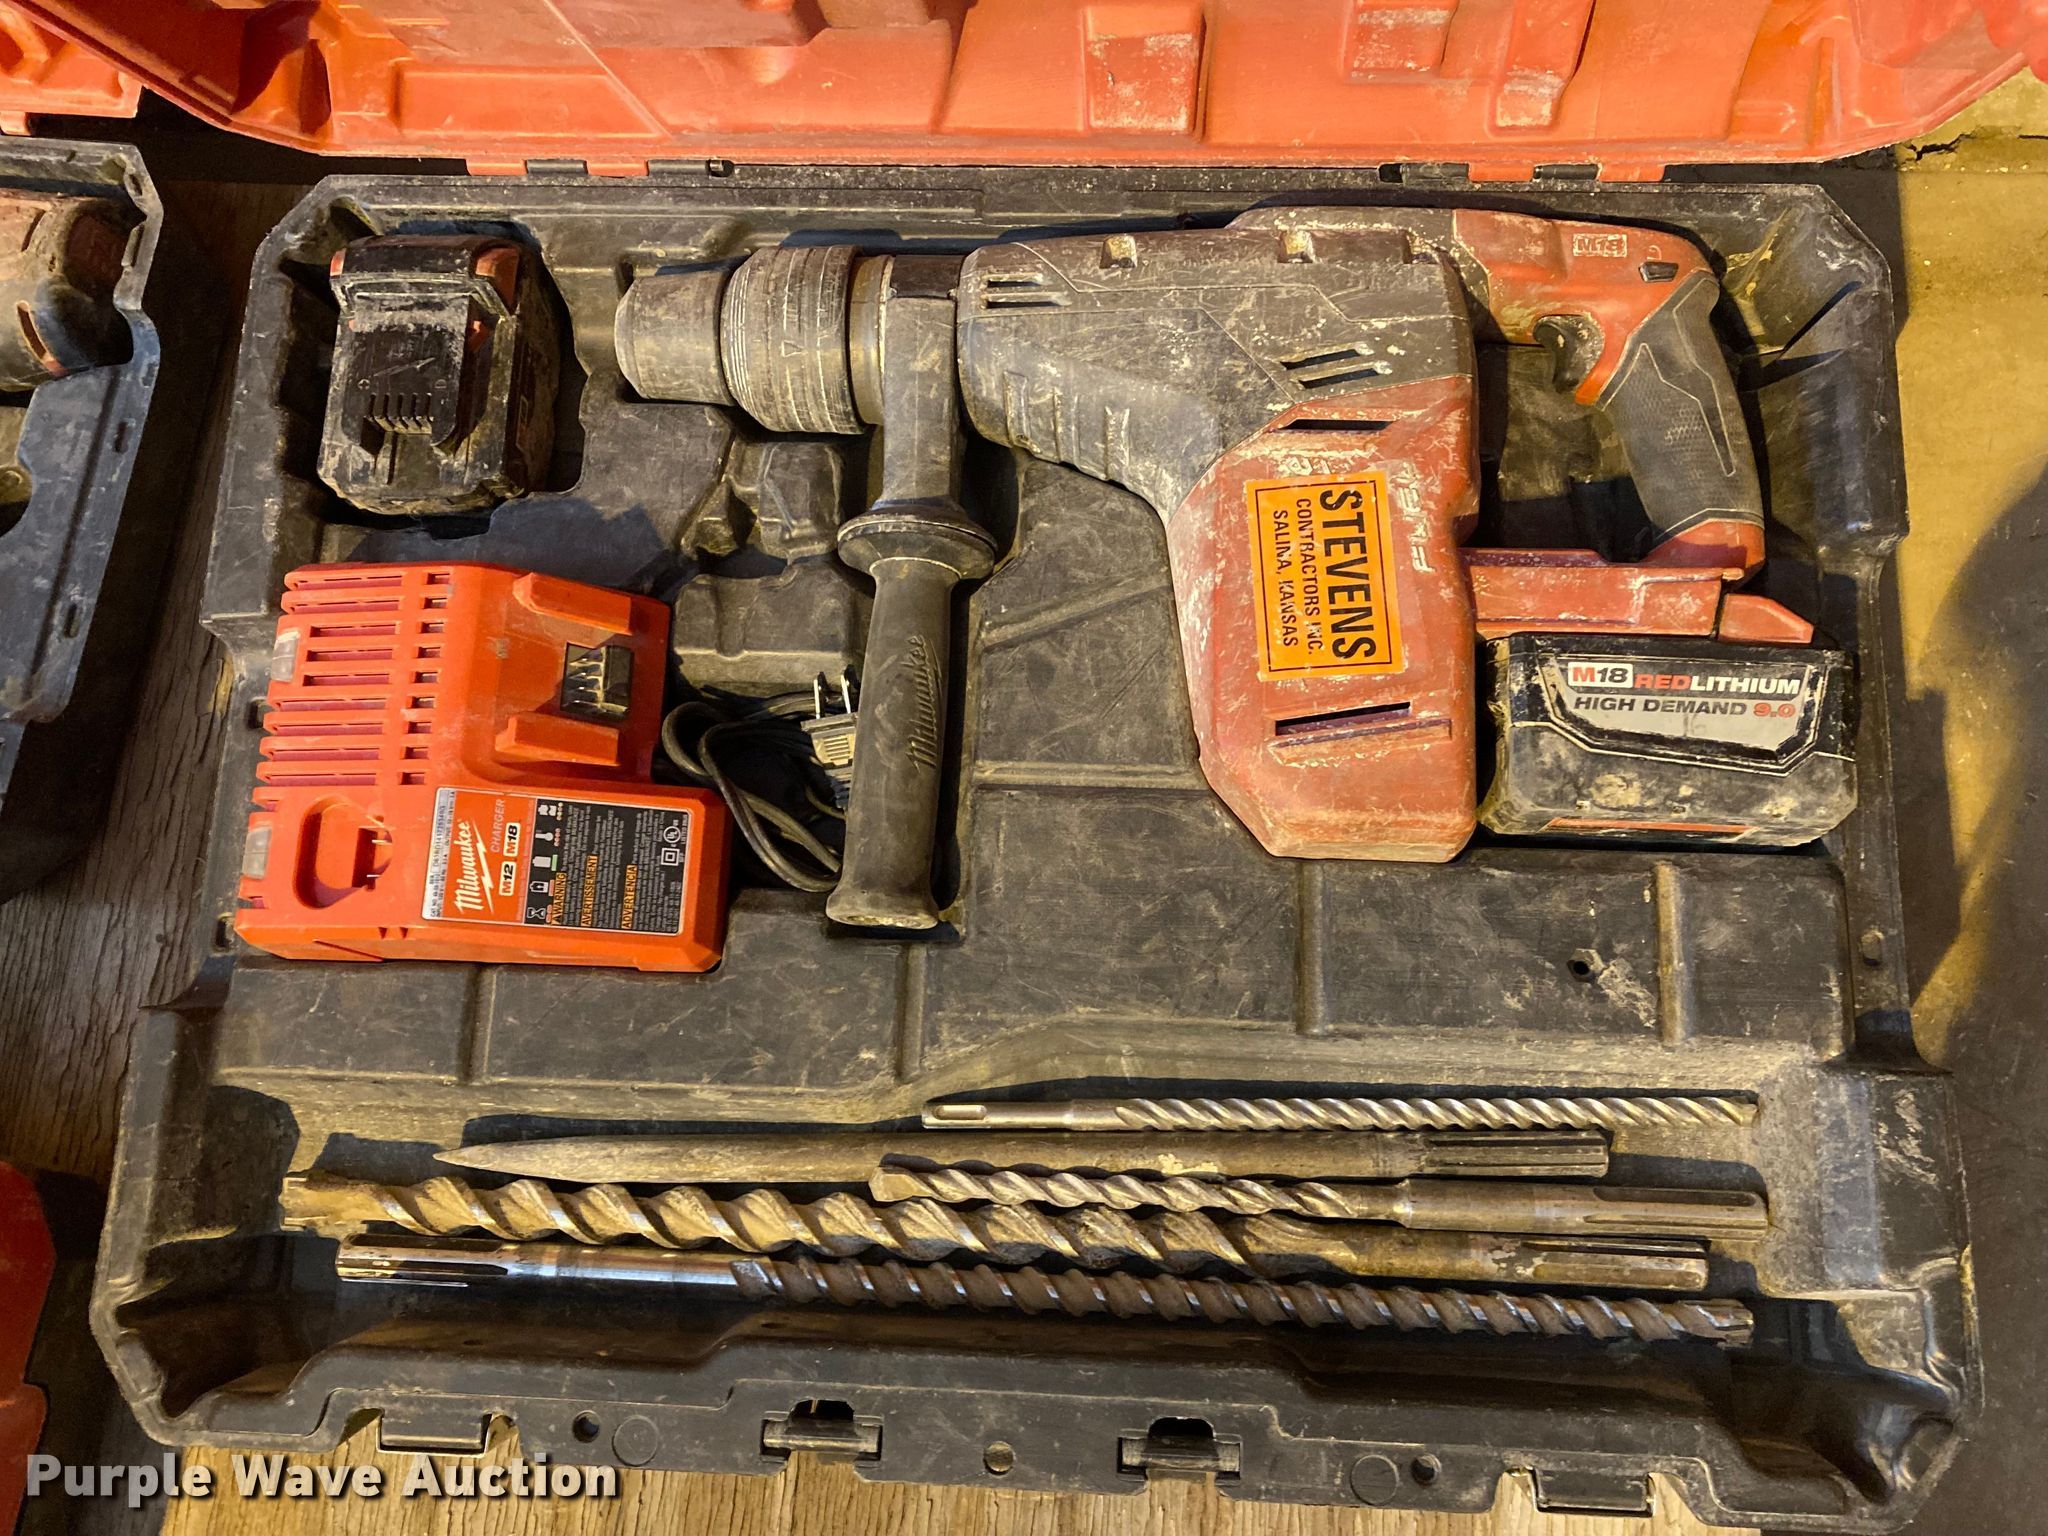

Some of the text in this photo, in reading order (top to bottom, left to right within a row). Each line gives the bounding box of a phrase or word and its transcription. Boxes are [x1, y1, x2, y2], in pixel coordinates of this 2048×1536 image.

[1576, 238, 1623, 254] M18
[1273, 510, 1299, 647] SALINA, KANSAS
[1296, 498, 1320, 617] CONTRACTORS
[1319, 489, 1377, 660] STEVENS
[1305, 622, 1323, 655] INC.
[900, 634, 938, 773] Milwaukee
[1572, 666, 1801, 695] M18 REDLITHIUM
[1574, 696, 1796, 718] HIGH DEMAND 9.0
[490, 799, 506, 853] CHARGER
[502, 824, 518, 893] M12 M18
[454, 819, 484, 914] Milwaukee
[553, 873, 567, 920] WARNING
[582, 856, 598, 926] AVERTISSEMENT
[623, 866, 637, 928] ADVERTENCIA
